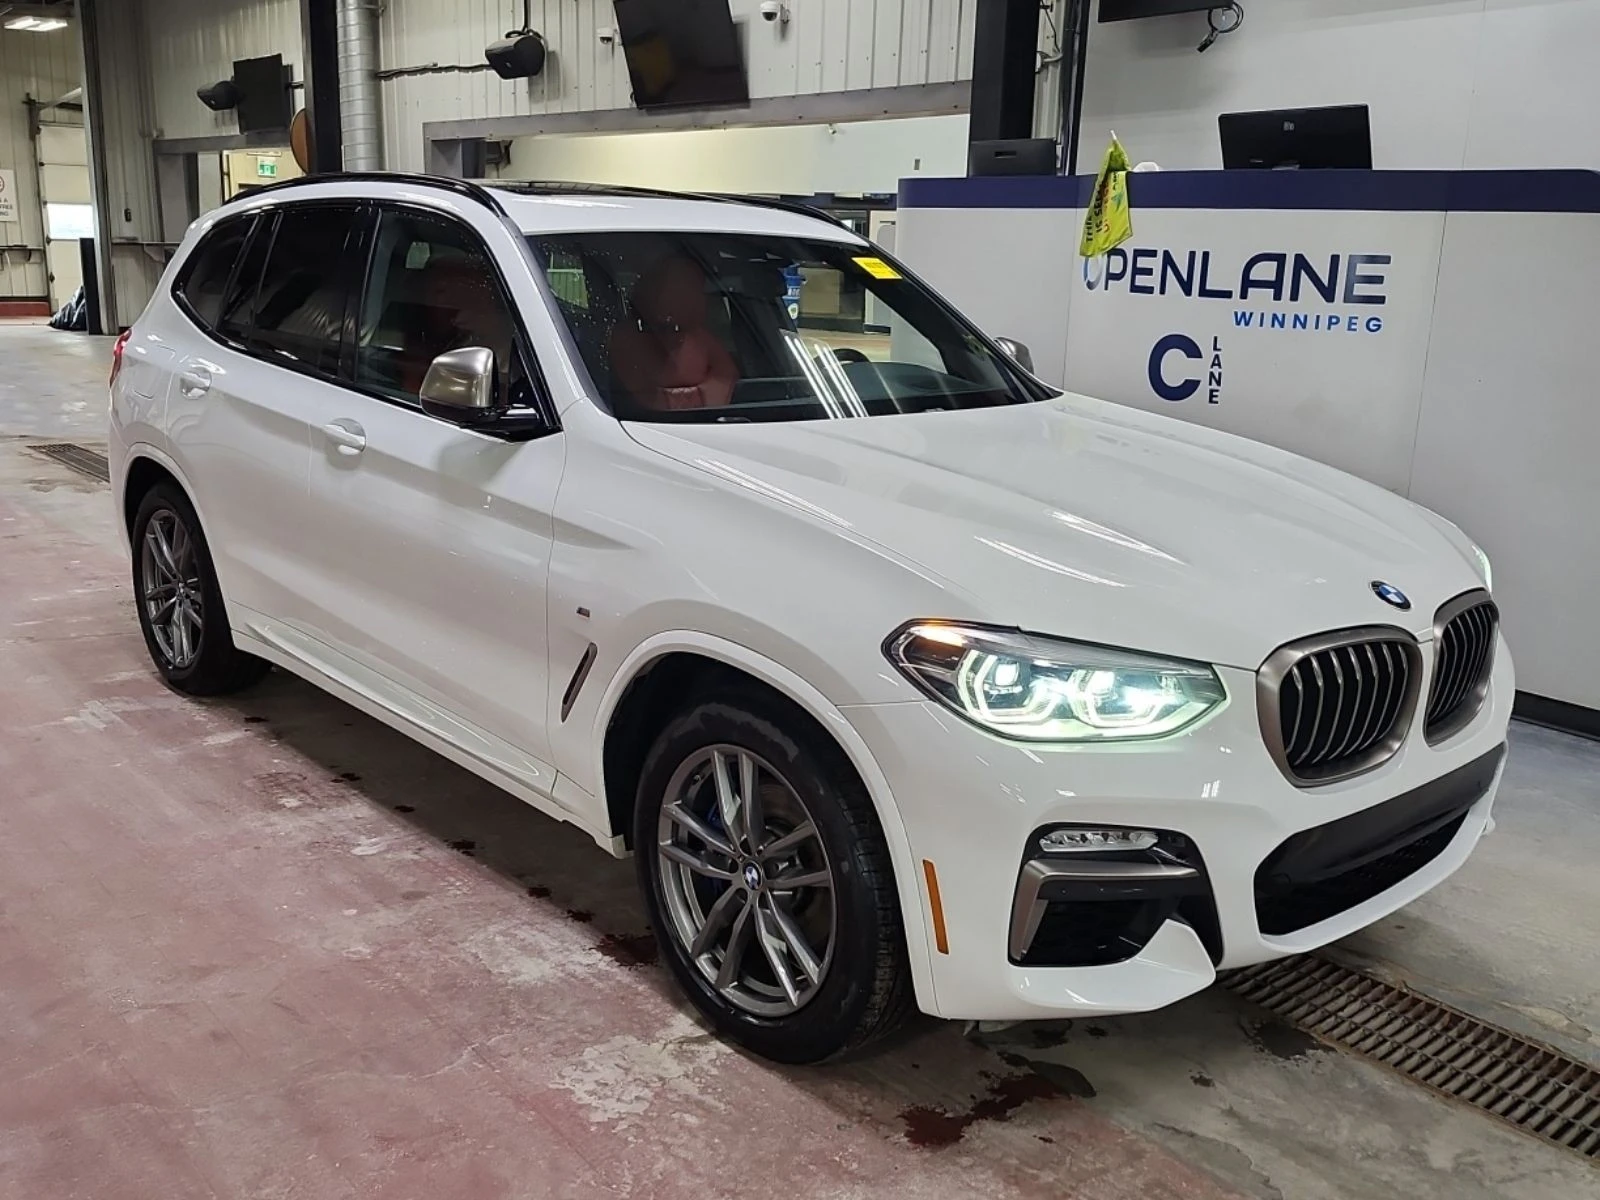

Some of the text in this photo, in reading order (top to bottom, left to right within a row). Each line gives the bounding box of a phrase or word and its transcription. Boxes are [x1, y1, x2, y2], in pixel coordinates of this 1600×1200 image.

[1083, 247, 1392, 305] OPENLANE
[1233, 310, 1383, 333] WINNIPEG
[1148, 333, 1204, 402] C
[1208, 335, 1222, 405] LANE
